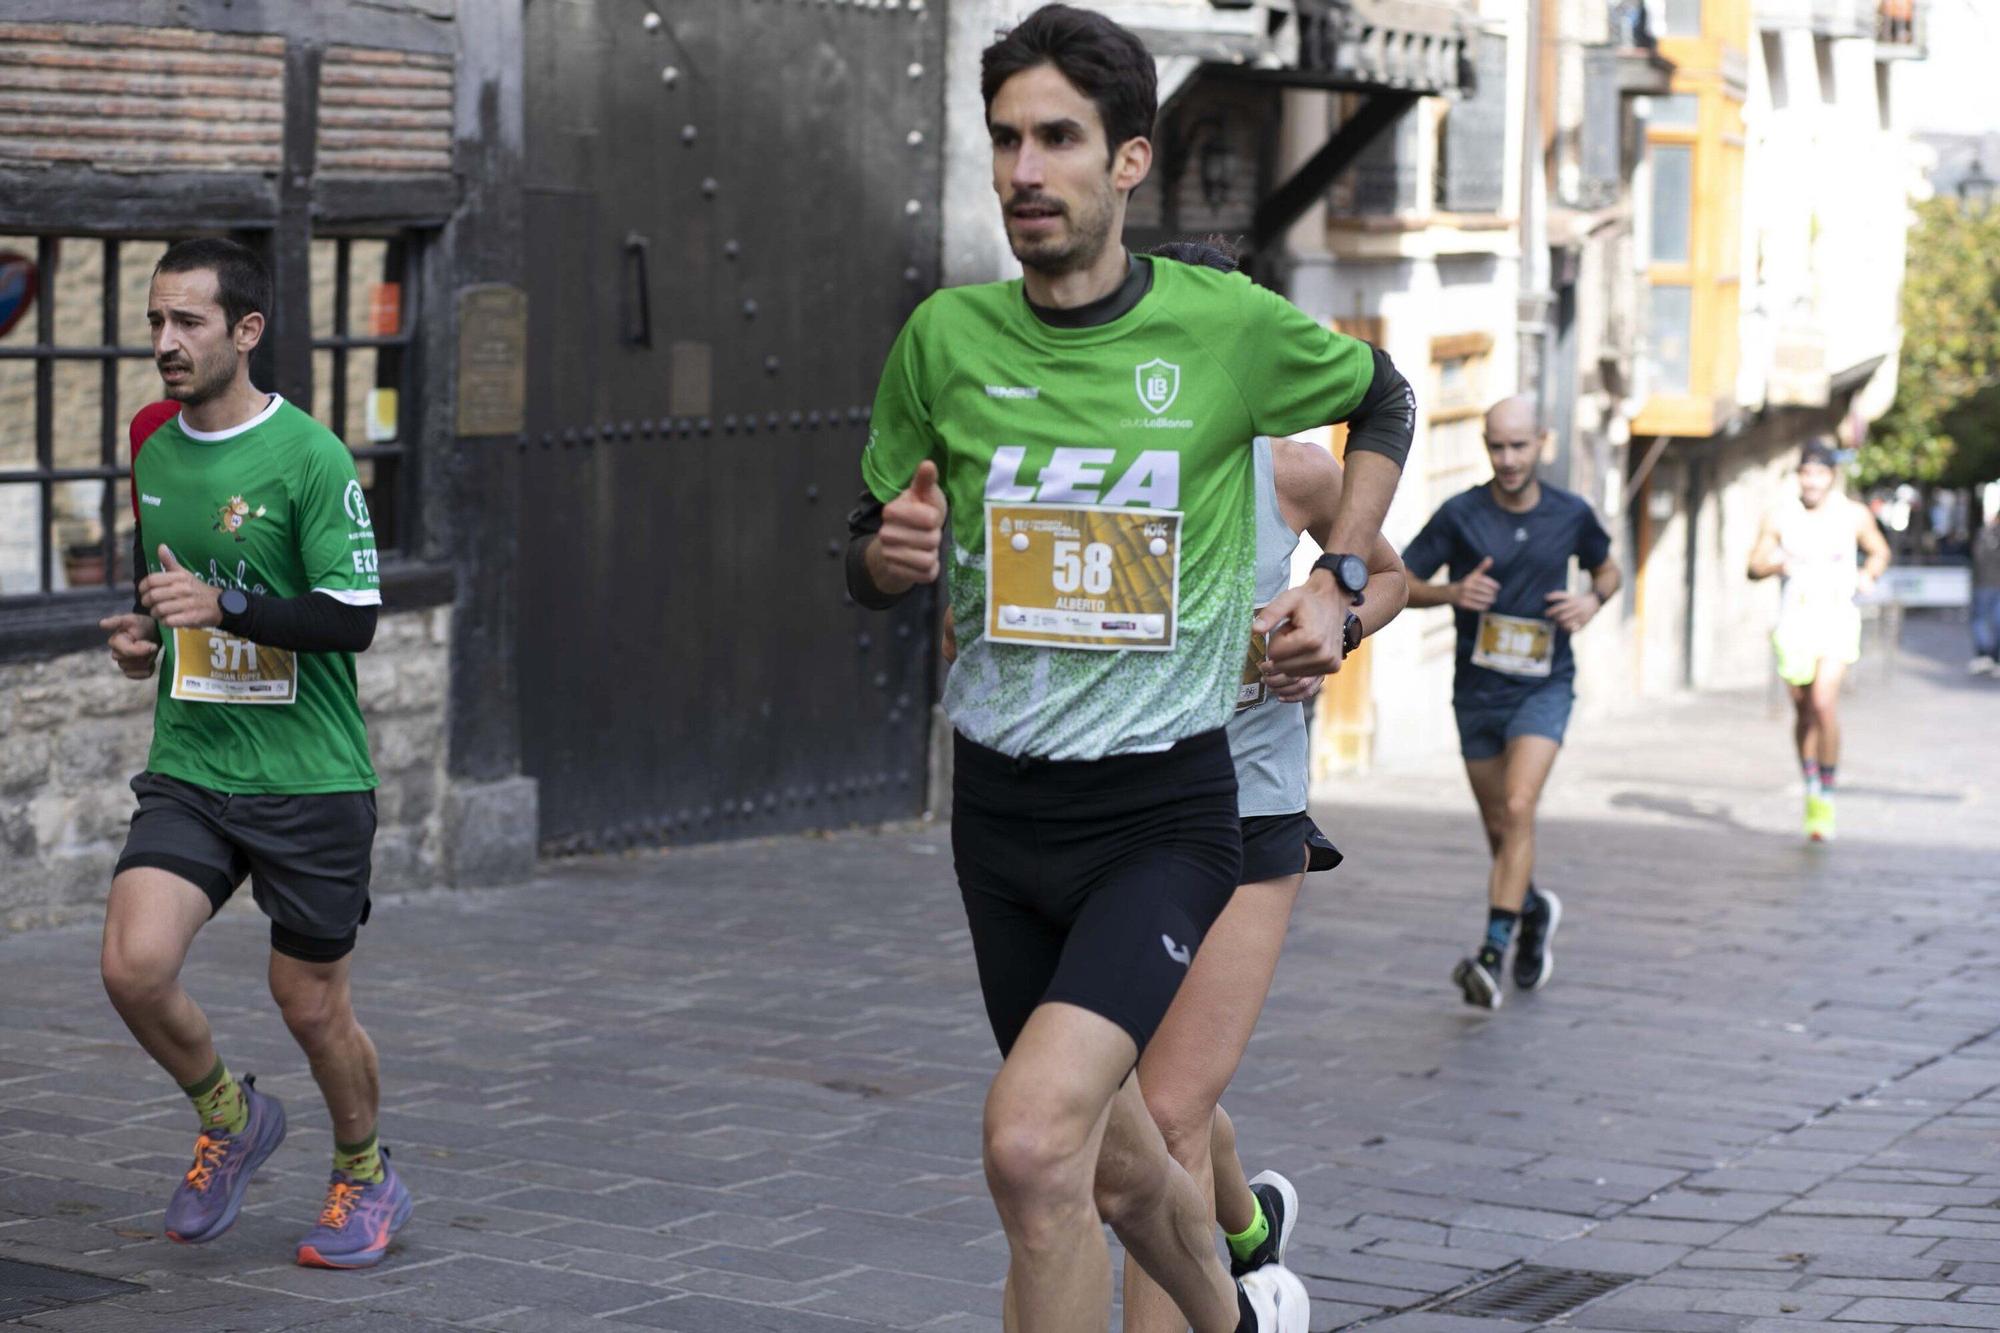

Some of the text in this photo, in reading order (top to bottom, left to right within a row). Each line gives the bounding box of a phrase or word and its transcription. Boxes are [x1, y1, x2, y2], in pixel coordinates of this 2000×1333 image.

[984, 446, 1180, 510] LEA
[1052, 541, 1113, 595] 58
[1055, 597, 1106, 612] ALBERTO
[208, 637, 257, 670] 371
